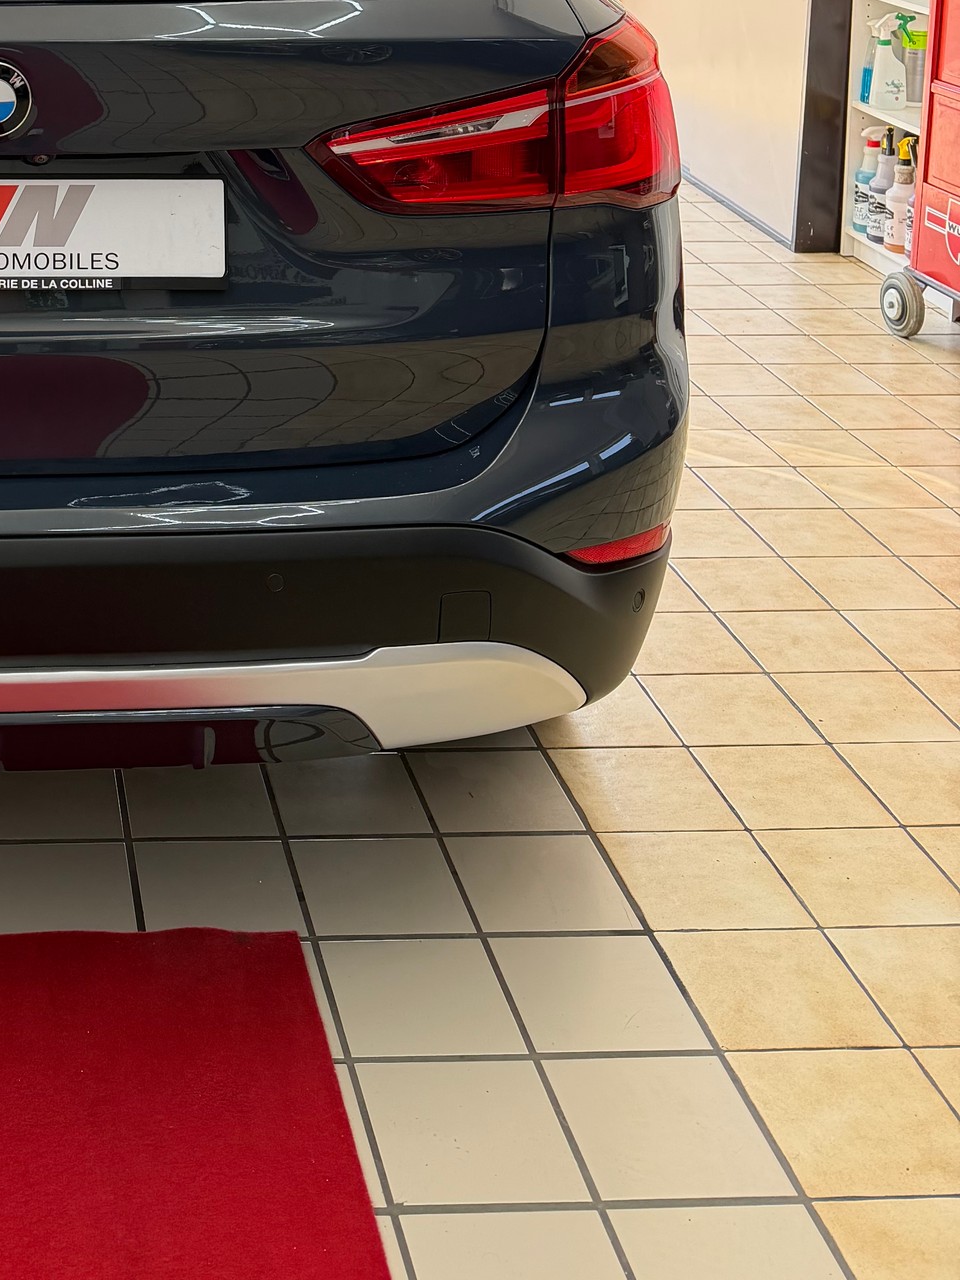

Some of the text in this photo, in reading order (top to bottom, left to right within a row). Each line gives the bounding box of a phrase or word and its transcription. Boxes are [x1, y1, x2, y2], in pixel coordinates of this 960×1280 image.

[21, 278, 39, 290] DE
[41, 278, 57, 290] LA
[59, 278, 114, 290] COLLINE
